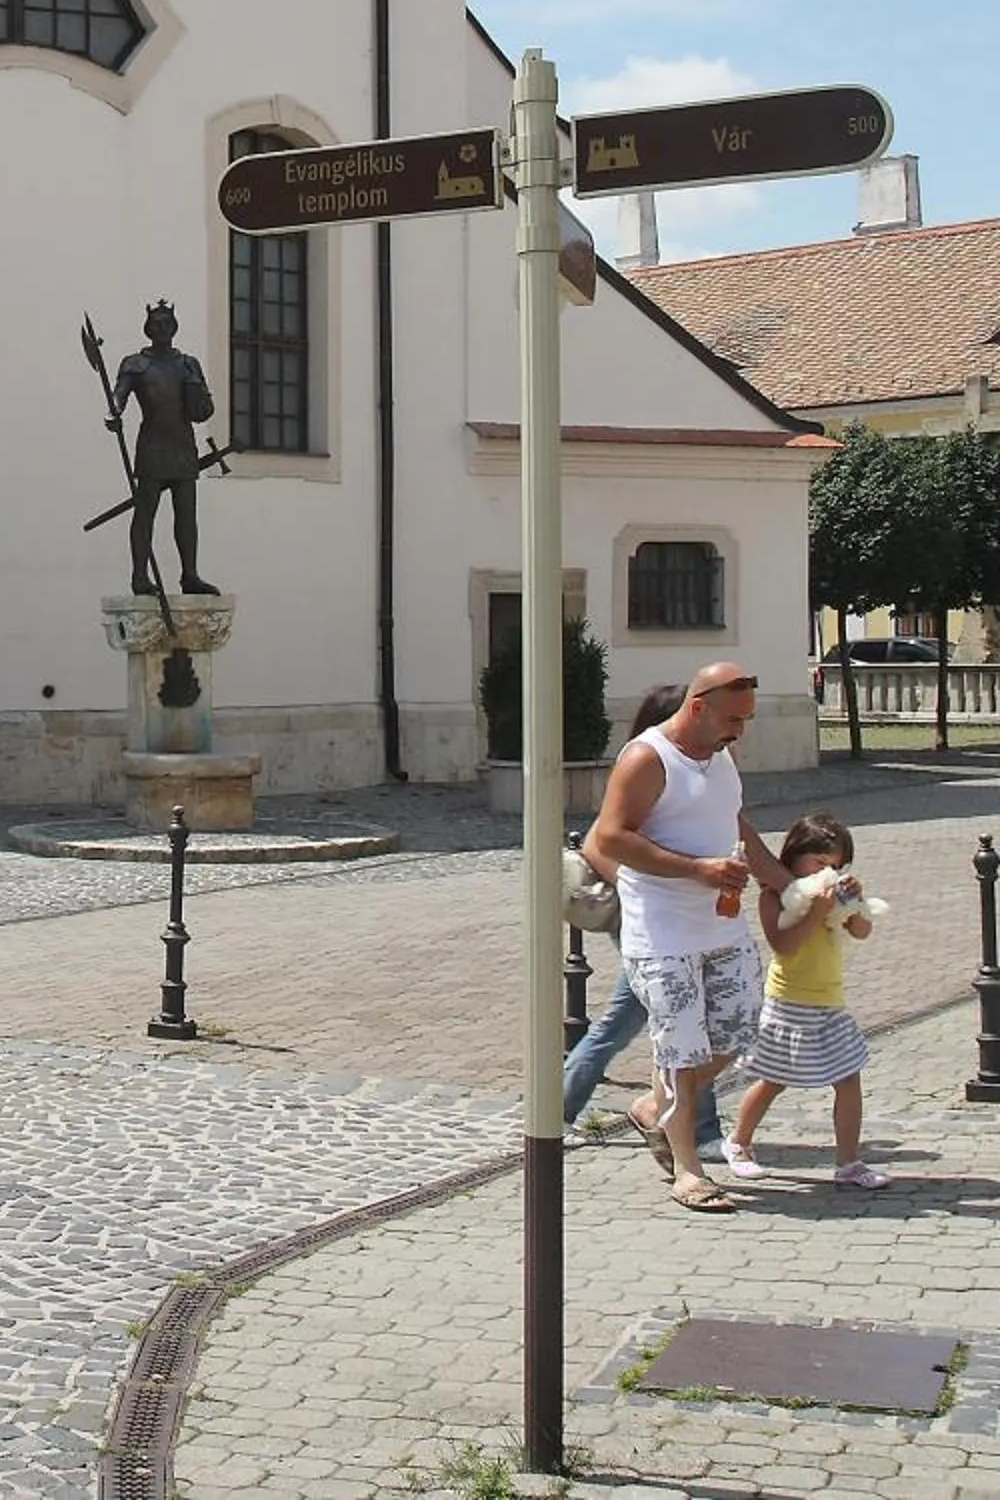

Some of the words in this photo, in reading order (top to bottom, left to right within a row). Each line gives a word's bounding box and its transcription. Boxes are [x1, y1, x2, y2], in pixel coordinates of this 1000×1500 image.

[711, 123, 752, 154] Vár
[848, 115, 878, 135] 500
[284, 151, 405, 185] Evangélikus
[299, 185, 388, 217] templom
